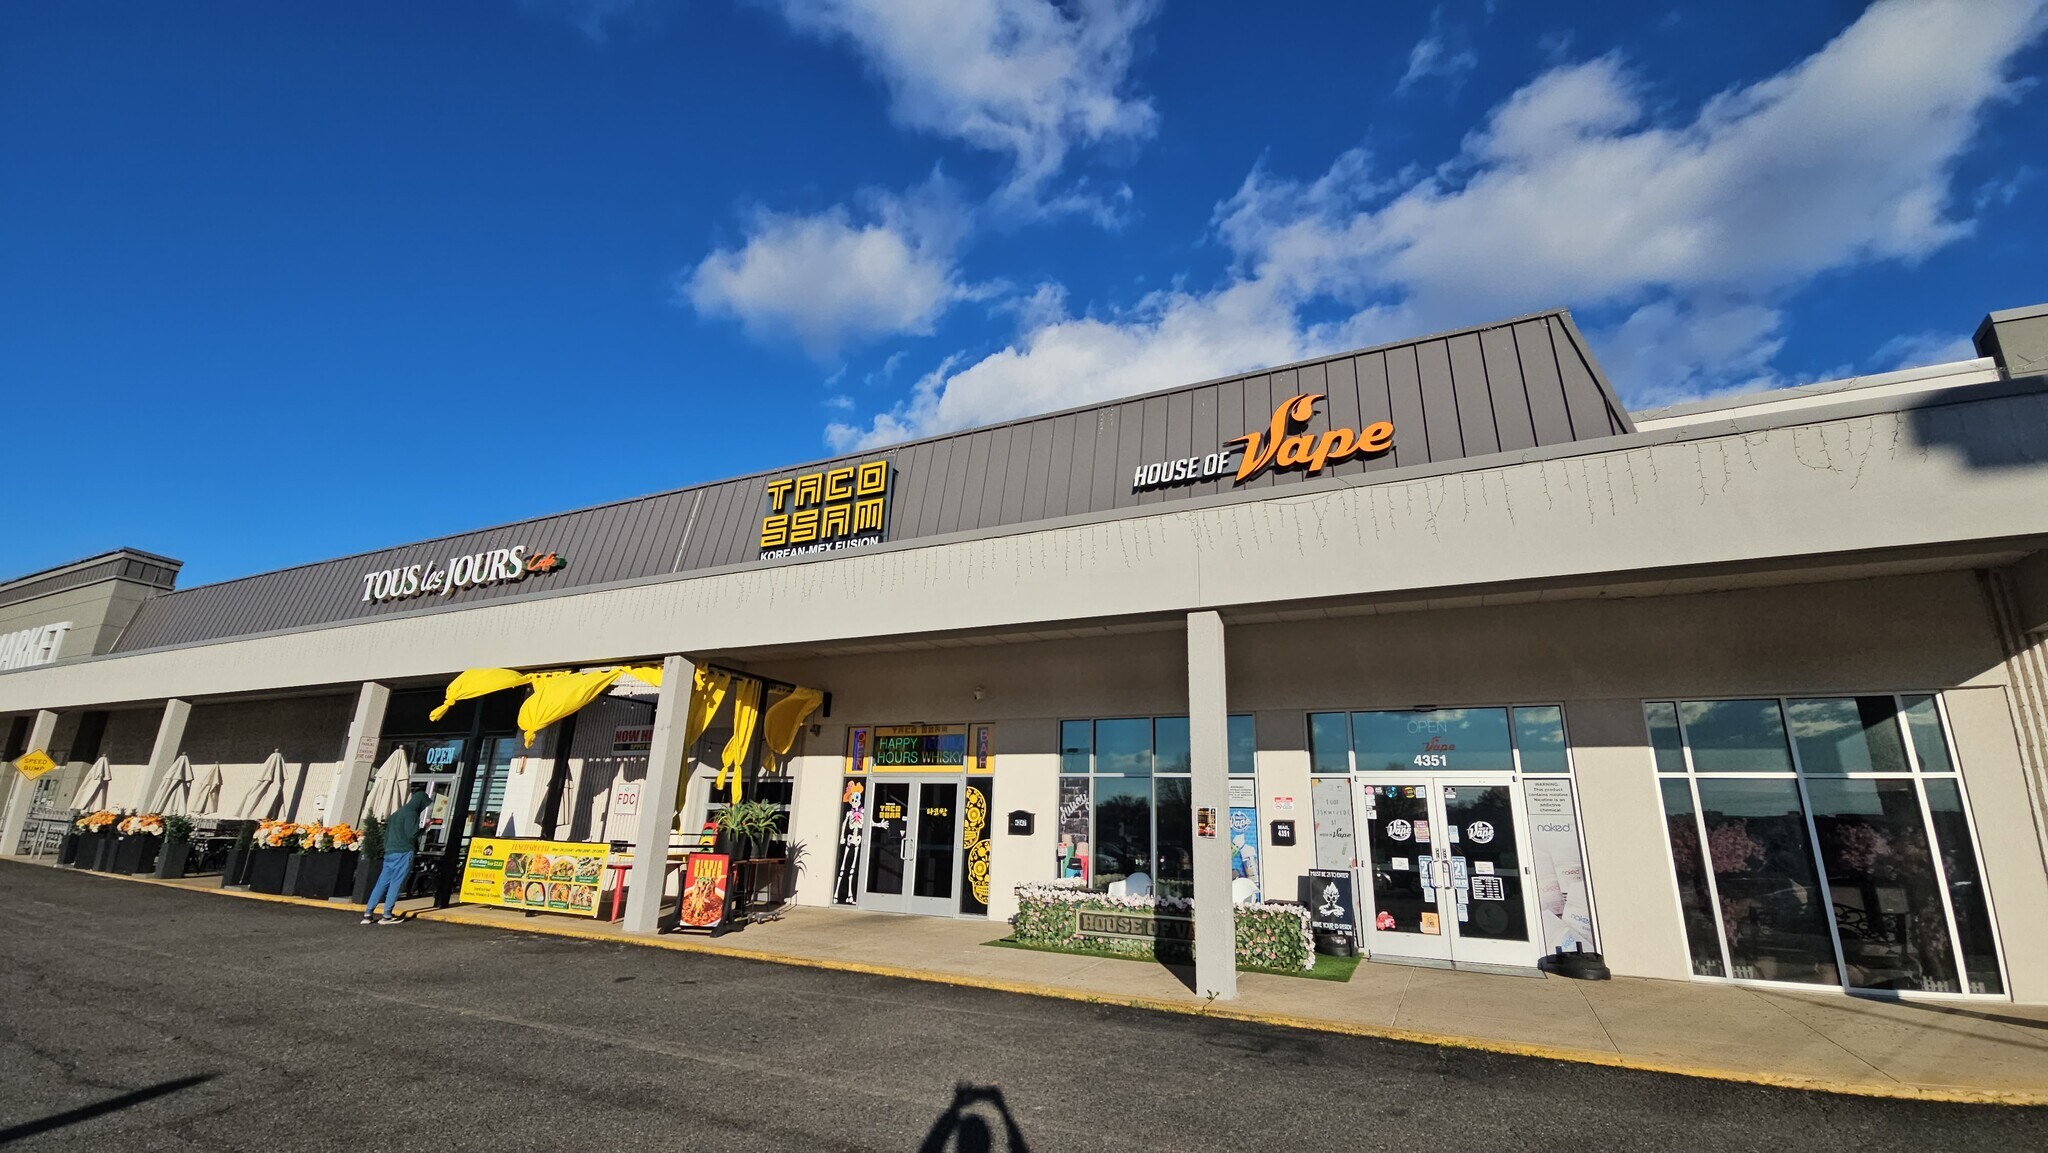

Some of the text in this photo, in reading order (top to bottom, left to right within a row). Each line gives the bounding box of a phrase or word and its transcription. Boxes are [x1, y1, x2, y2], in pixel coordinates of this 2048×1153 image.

[1133, 393, 1394, 487] HOUSE OF Vape
[767, 460, 887, 511] TACO
[760, 498, 884, 548] SSAM
[835, 536, 879, 549] FUSION
[362, 564, 421, 601] TOUS
[420, 560, 445, 591] les
[440, 545, 525, 596] JOURS
[1407, 720, 1447, 734] OPEN
[614, 730, 640, 742] NOW
[879, 737, 918, 750] HAPPY
[979, 729, 988, 768] BAR
[1423, 736, 1455, 752] Vape
[426, 747, 455, 764] OPEN
[877, 750, 964, 764] HOURS WHISKY
[1414, 754, 1447, 767] 4351
[617, 793, 636, 805] FDC
[1332, 827, 1352, 838] Vape
[1386, 819, 1412, 837] Vape
[1466, 821, 1494, 840] Vape
[1537, 823, 1570, 832] naked
[1454, 861, 1466, 875] 21
[1083, 914, 1143, 934] HOUSE
